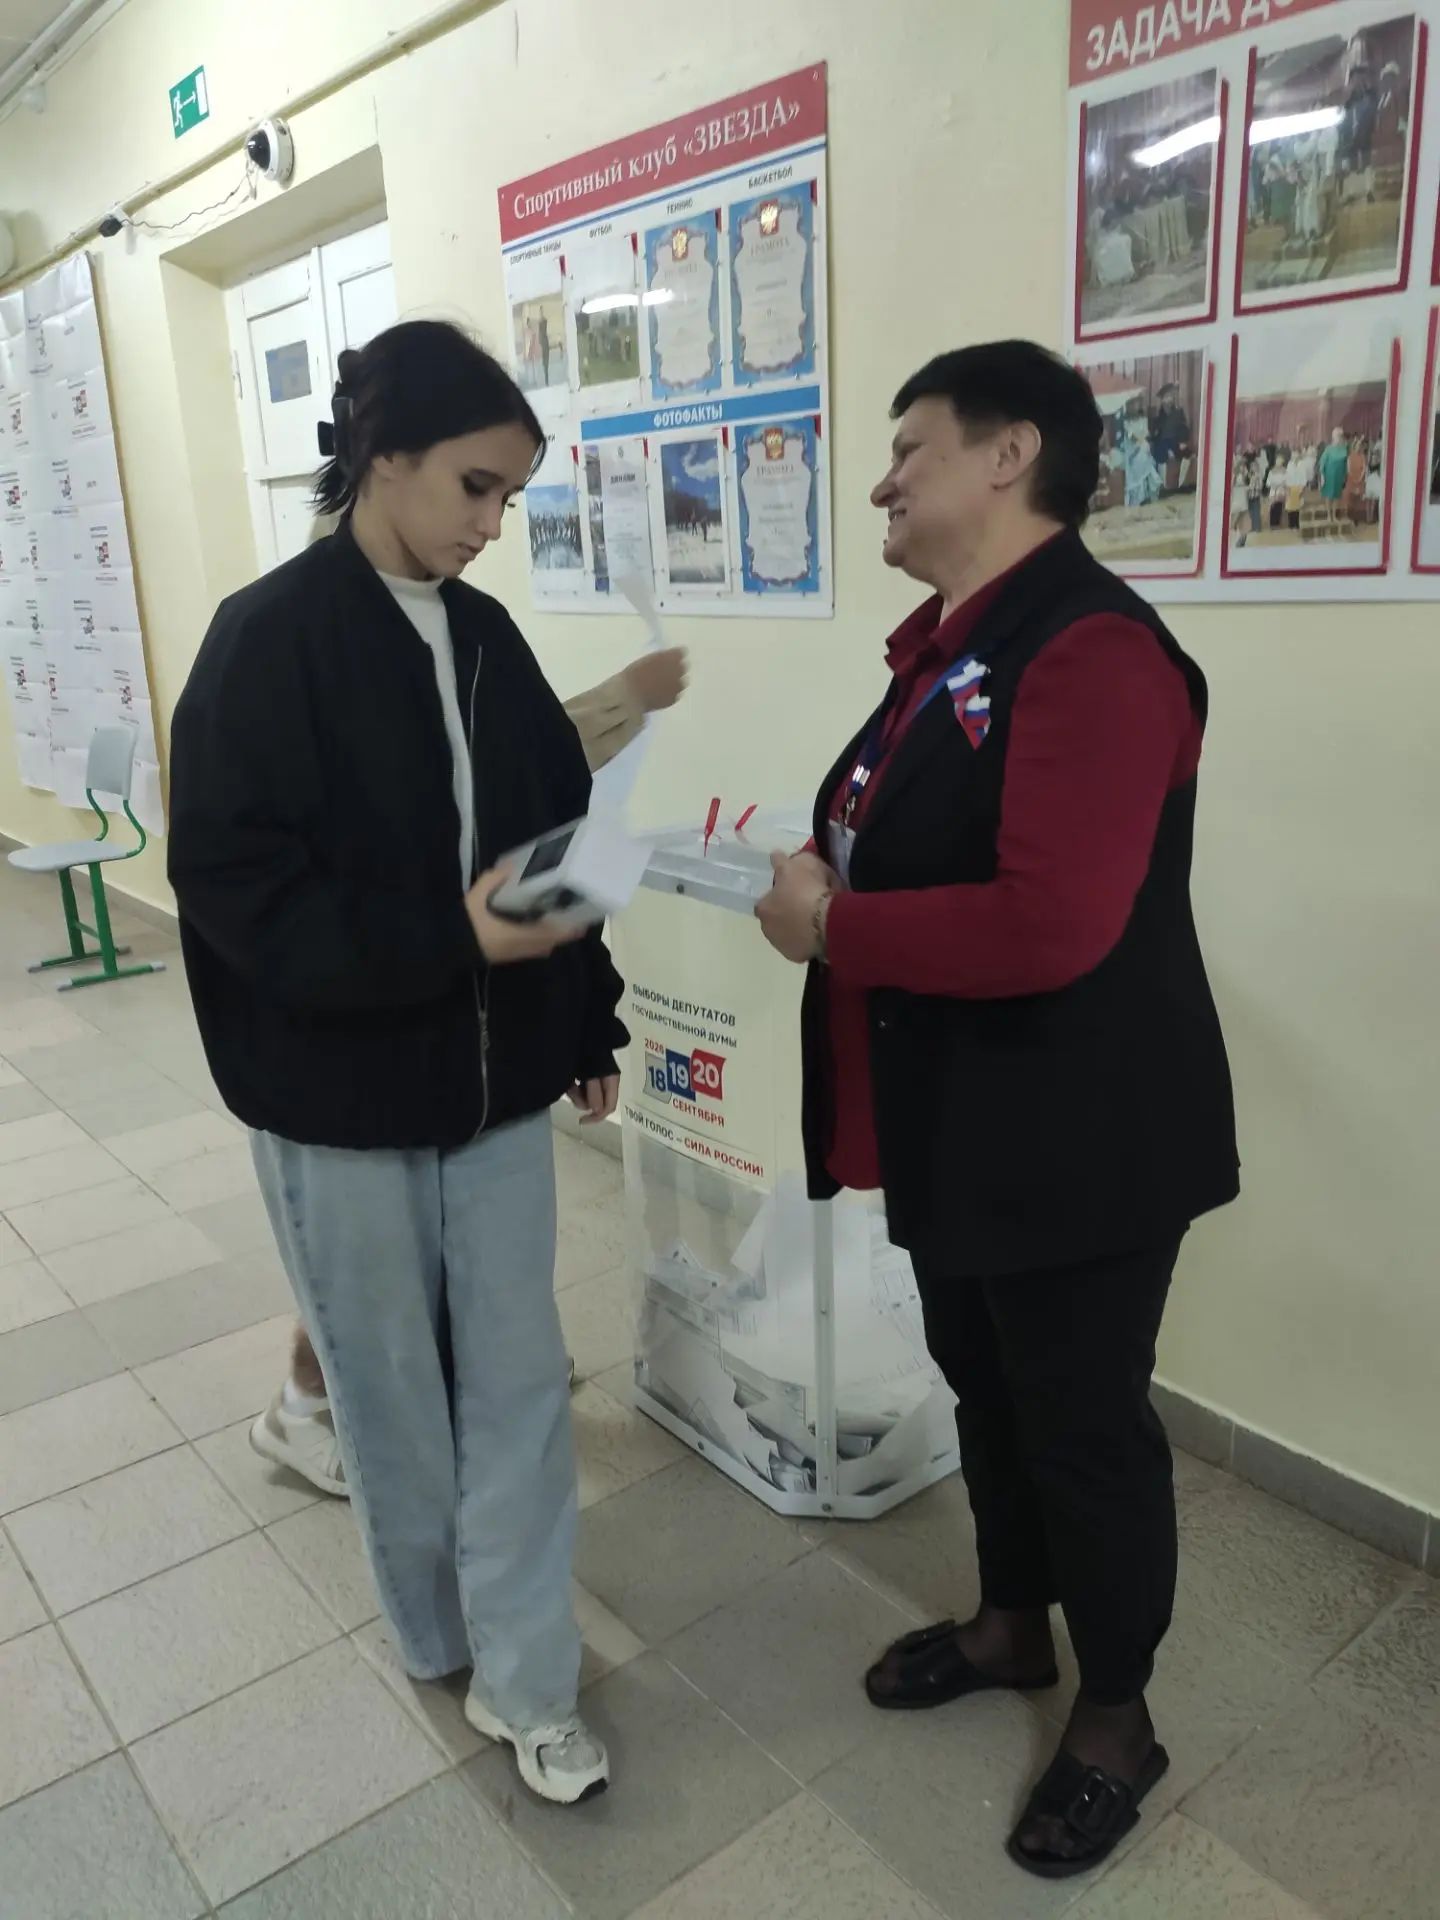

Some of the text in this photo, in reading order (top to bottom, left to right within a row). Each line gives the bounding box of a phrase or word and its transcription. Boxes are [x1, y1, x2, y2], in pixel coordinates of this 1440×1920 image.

[1086, 0, 1232, 71] ЗАДАЧА
[513, 97, 800, 219] Спортивный клуб «ЗВЕЗДА»
[747, 165, 793, 189] БАСКЕТБОЛ
[666, 198, 693, 215] ТЕННИС
[589, 224, 613, 239] ФУТБОЛ
[510, 245, 542, 266] СПОРТИВНЫЕ
[653, 403, 723, 428] ФОТОФАКТЫ
[632, 983, 736, 1027] ВЫБОРЫ ДЕПУТАТОВ
[632, 1002, 737, 1048] ГОСУДАРСТВЕННОЙ ДУМЫ
[648, 1058, 720, 1092] 18 19 20
[672, 1098, 725, 1128] СЕНТЯБРЯ
[624, 1105, 644, 1125] ТВОЙ
[645, 1117, 674, 1141] ГОЛОС
[684, 1137, 712, 1158] СИЛА
[714, 1149, 764, 1178] РОССИИ!
